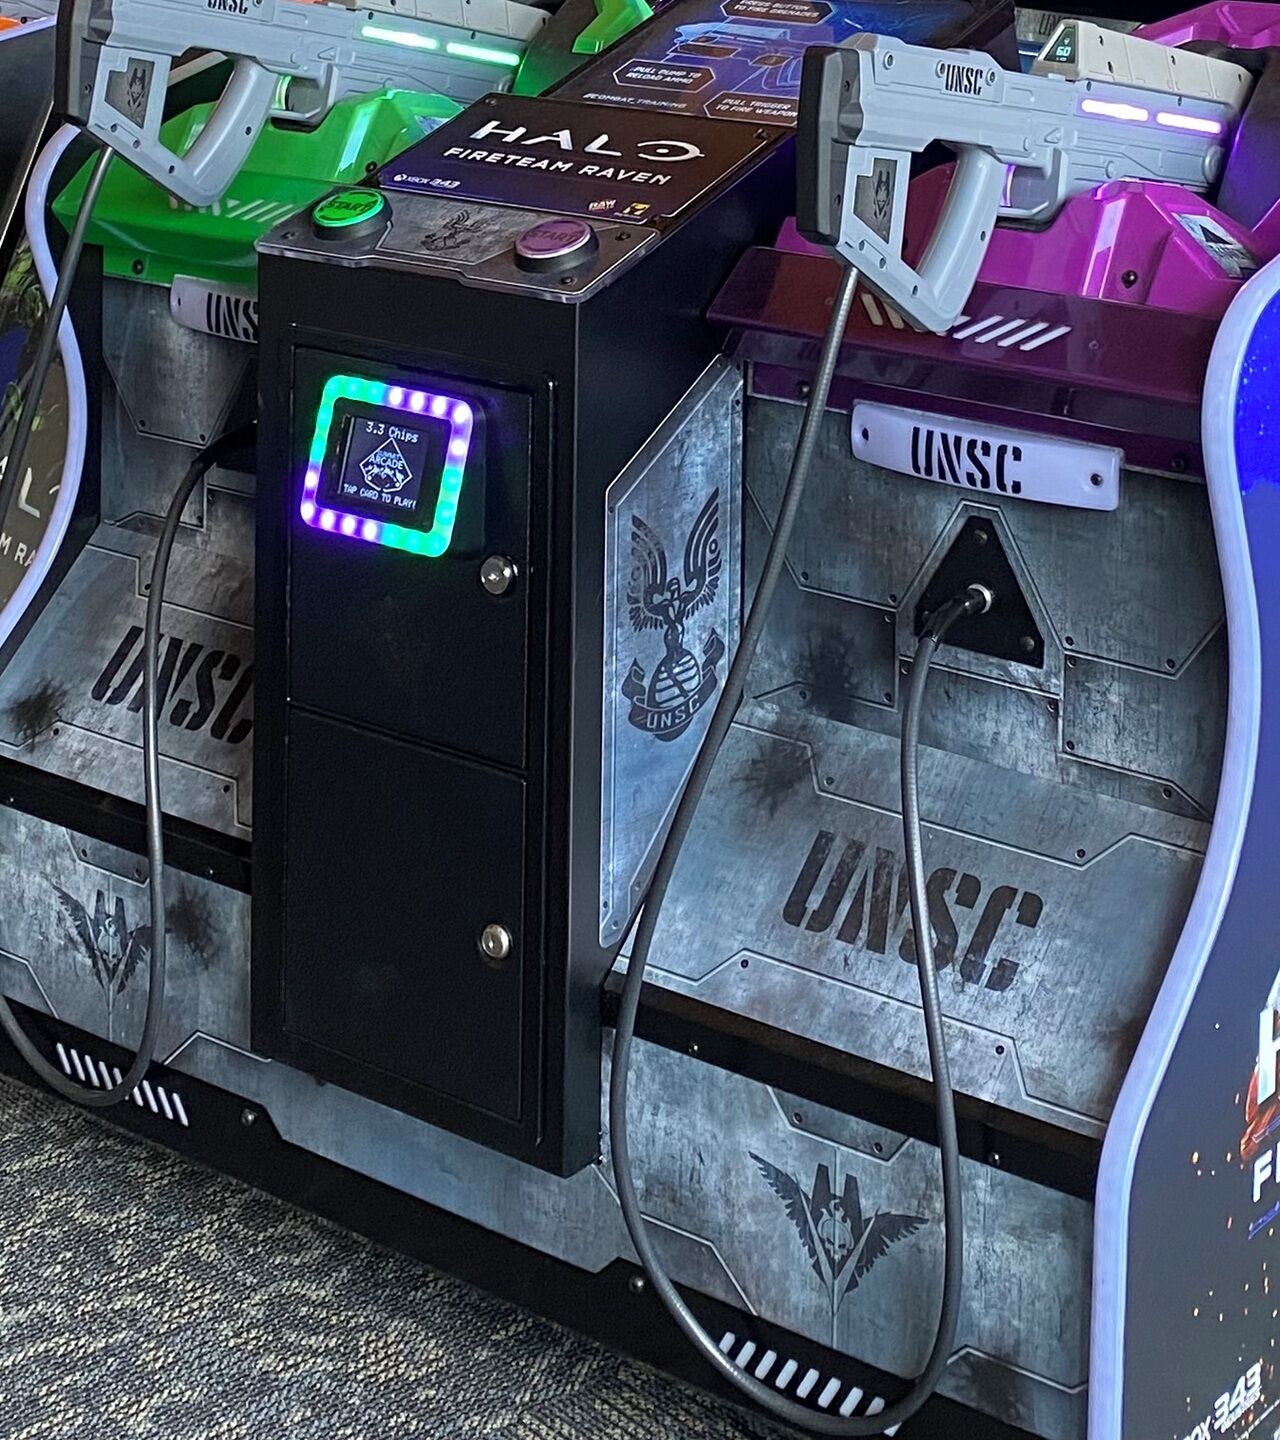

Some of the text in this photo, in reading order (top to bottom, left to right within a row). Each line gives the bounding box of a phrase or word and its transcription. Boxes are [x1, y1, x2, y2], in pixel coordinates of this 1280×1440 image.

[772, 2, 810, 11] BUTTON
[1055, 46, 1072, 57] 60
[625, 72, 694, 85] RELOAD AMMO
[633, 65, 702, 79] PULL PUMP TO
[944, 63, 983, 97] UNSC
[715, 103, 798, 118] TO FIRE WEAPON
[721, 97, 792, 110] PULL TRIGGER
[469, 119, 706, 162] HALO
[443, 146, 673, 186] FIRETEAM RAVEN
[326, 198, 376, 212] START
[588, 199, 617, 211] RAW
[526, 229, 582, 243] START
[206, 291, 258, 341] UNS
[365, 421, 420, 444] 3.3 Chips
[368, 454, 404, 470] ARCADE
[910, 424, 1022, 495] UNSC
[343, 483, 358, 495] TAP
[381, 492, 391, 503] TO
[646, 693, 700, 729] UNSC
[782, 829, 1044, 994] UNSC
[1213, 1362, 1262, 1431] 343
